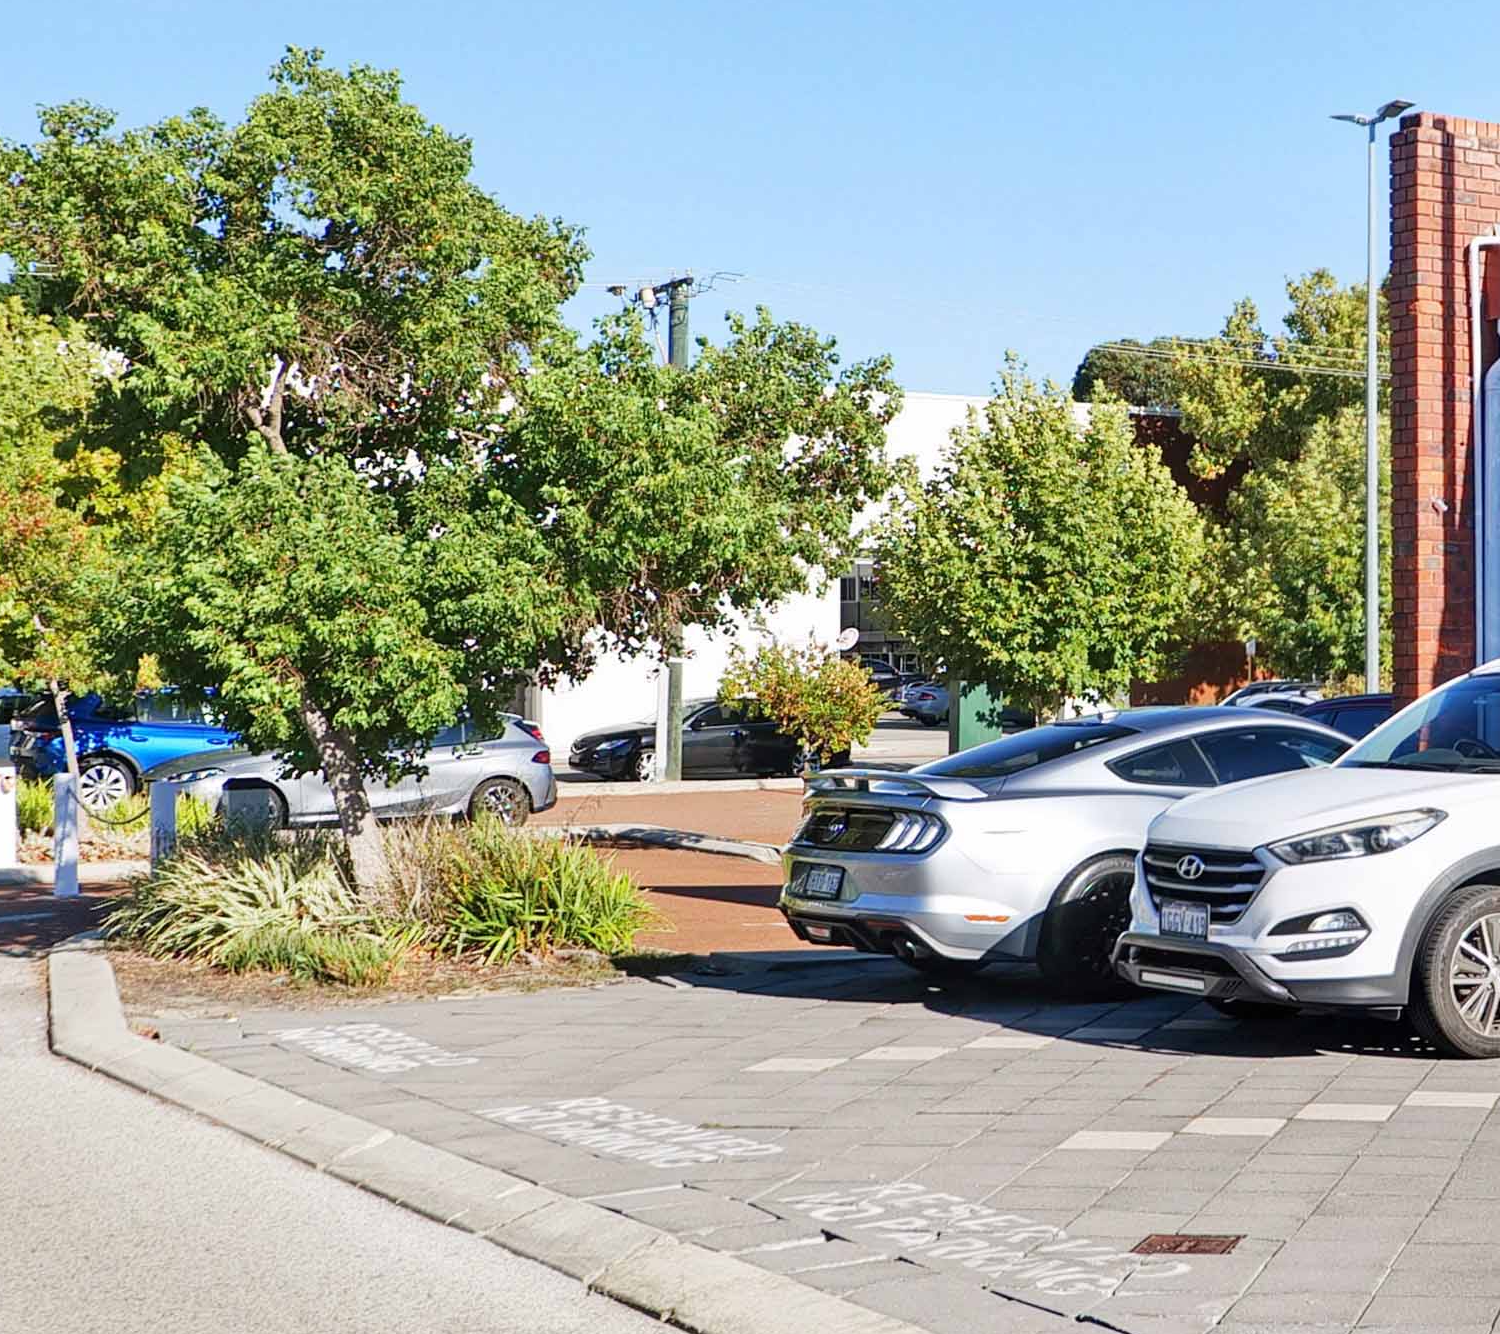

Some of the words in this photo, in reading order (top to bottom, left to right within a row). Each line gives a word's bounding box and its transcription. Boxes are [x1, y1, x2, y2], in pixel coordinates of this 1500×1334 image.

[474, 1105, 568, 1122] NO
[531, 1120, 720, 1167] PARKING
[544, 1096, 786, 1157] RESERVED
[777, 1191, 885, 1221] NO
[851, 1217, 1121, 1295] PARKING
[847, 1182, 1192, 1279] RESERVED
